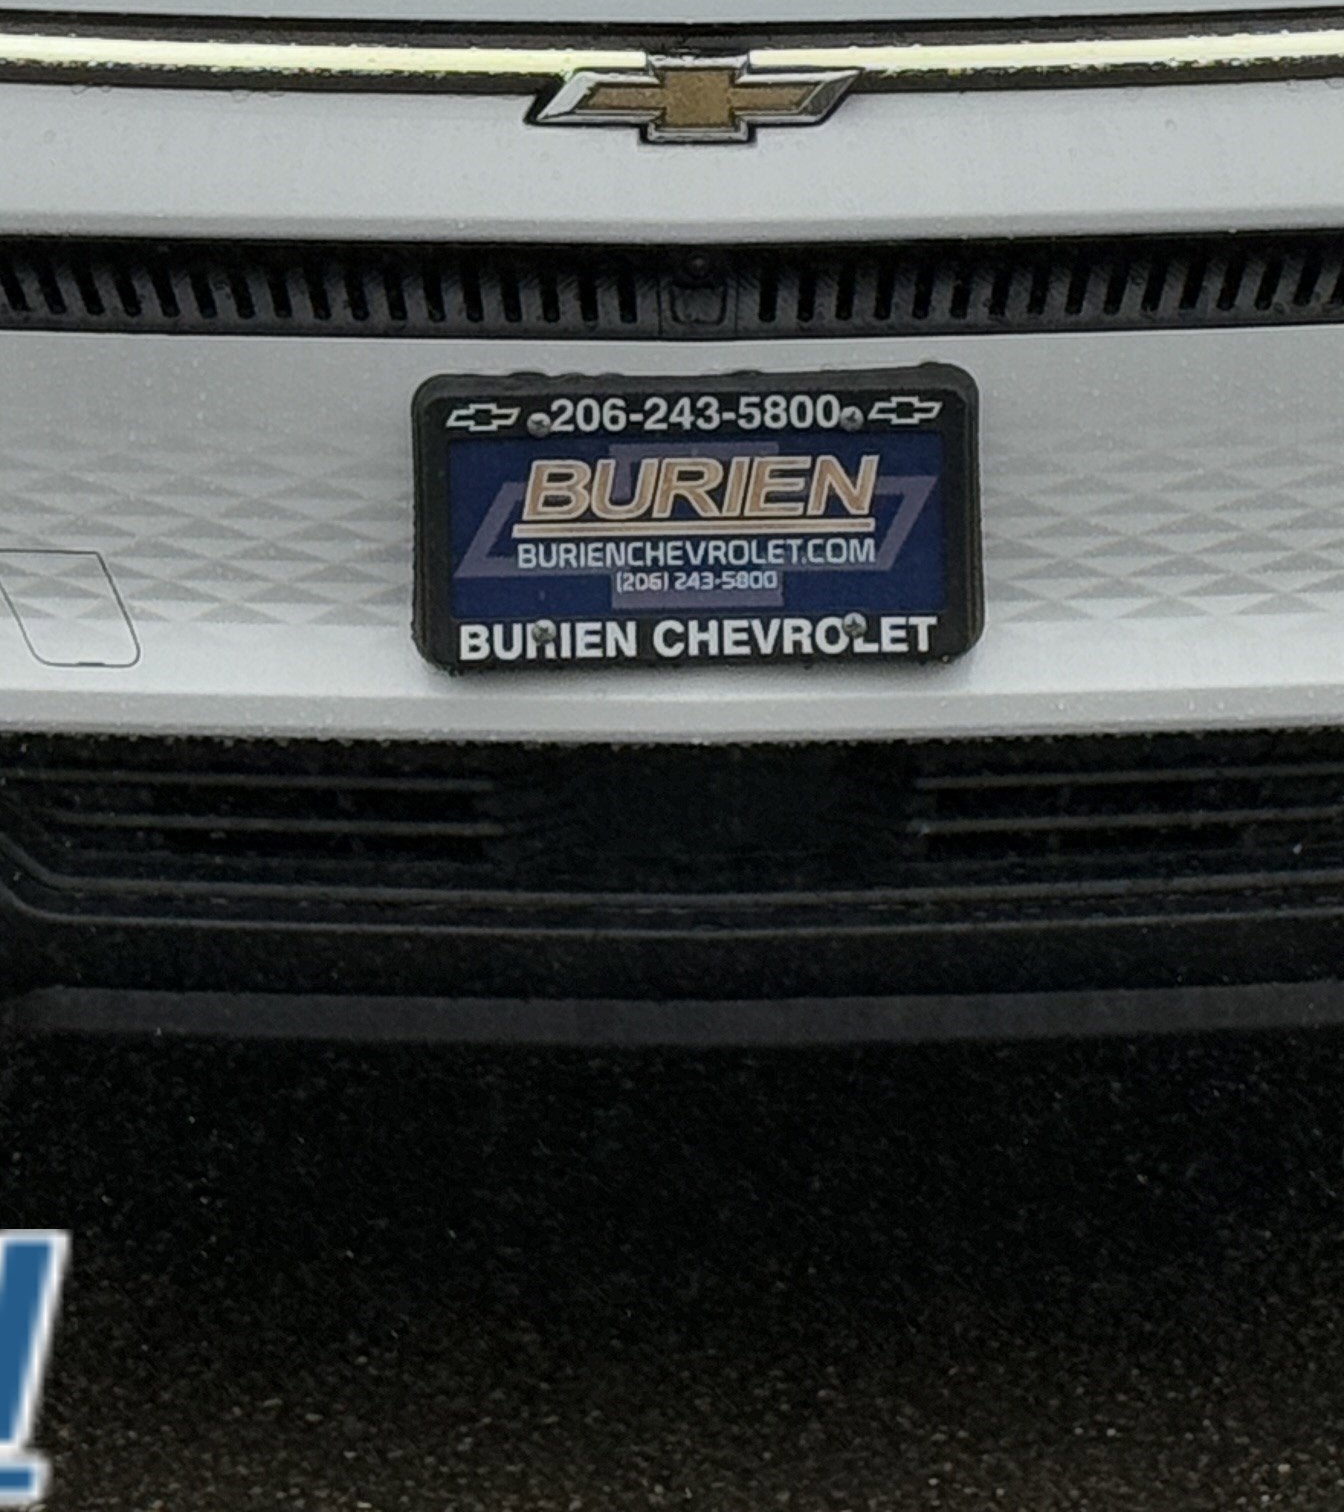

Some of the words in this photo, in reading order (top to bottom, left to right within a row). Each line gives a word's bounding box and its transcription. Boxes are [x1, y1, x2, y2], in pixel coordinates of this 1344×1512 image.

[550, 394, 840, 433] 206-243-5800
[522, 454, 880, 521] BURIEN
[517, 538, 876, 569] BURIENCHEVROLET.COM
[616, 571, 669, 593] (206)
[674, 570, 777, 590] 243-5800
[459, 620, 637, 661] BURIEN
[653, 615, 937, 657] CHEVROLET
